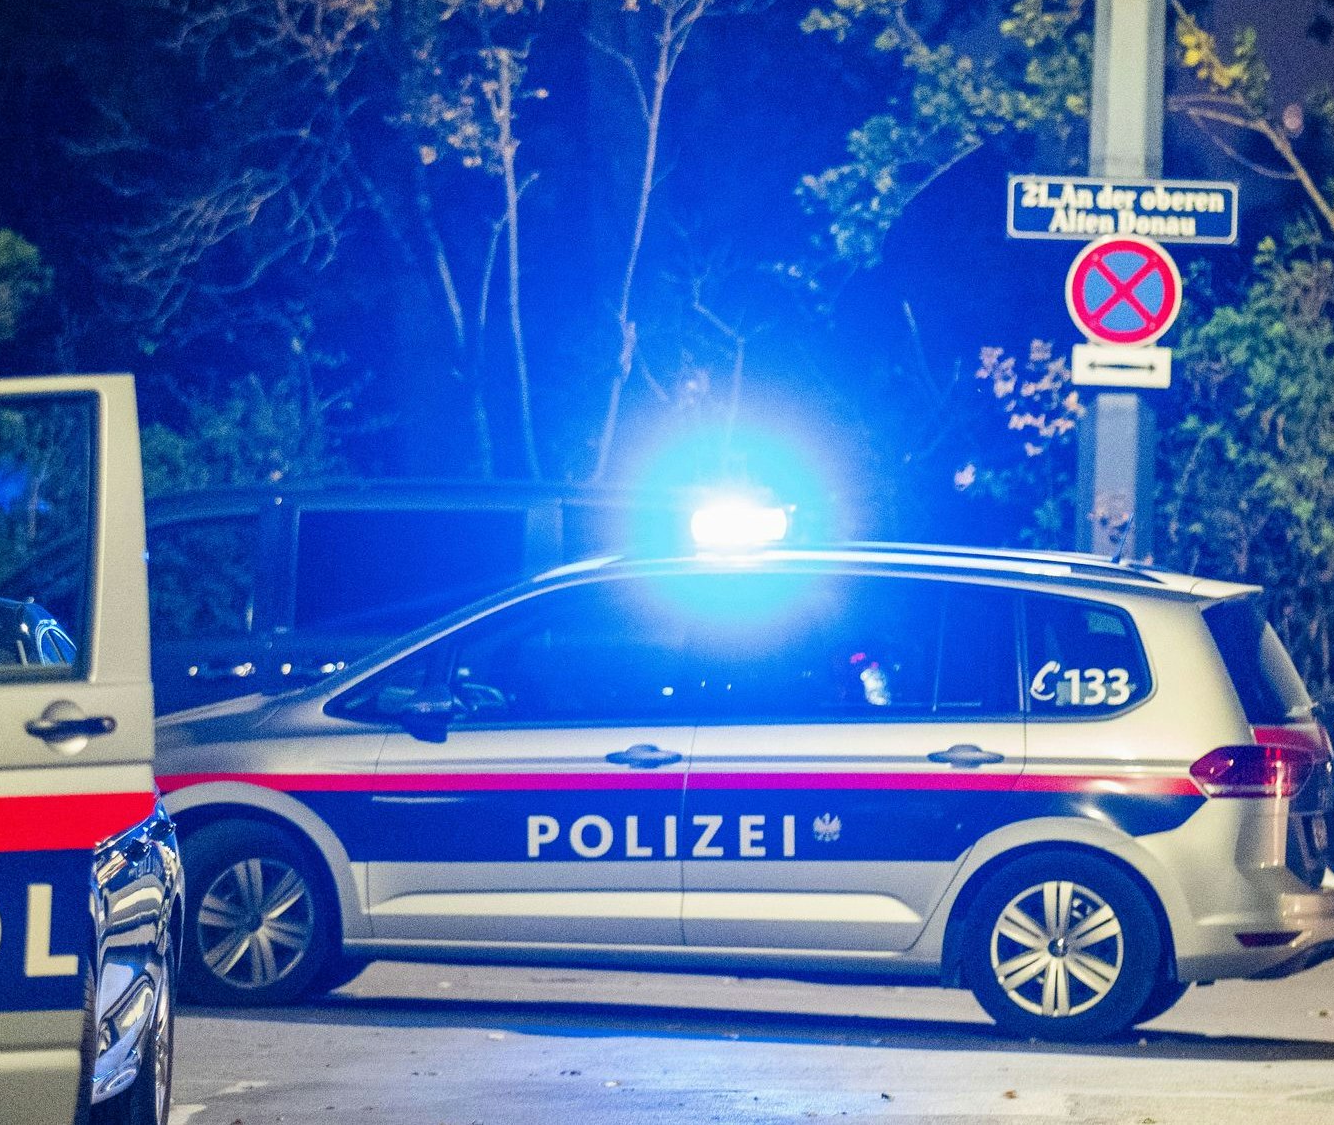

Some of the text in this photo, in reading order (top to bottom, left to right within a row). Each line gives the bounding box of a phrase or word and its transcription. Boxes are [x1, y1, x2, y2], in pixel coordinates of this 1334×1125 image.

[1096, 183, 1137, 211] der
[1139, 185, 1226, 213] oberen
[1048, 207, 1197, 237] Alten Donau
[1063, 668, 1131, 706] 133
[527, 814, 796, 859] POLIZEI
